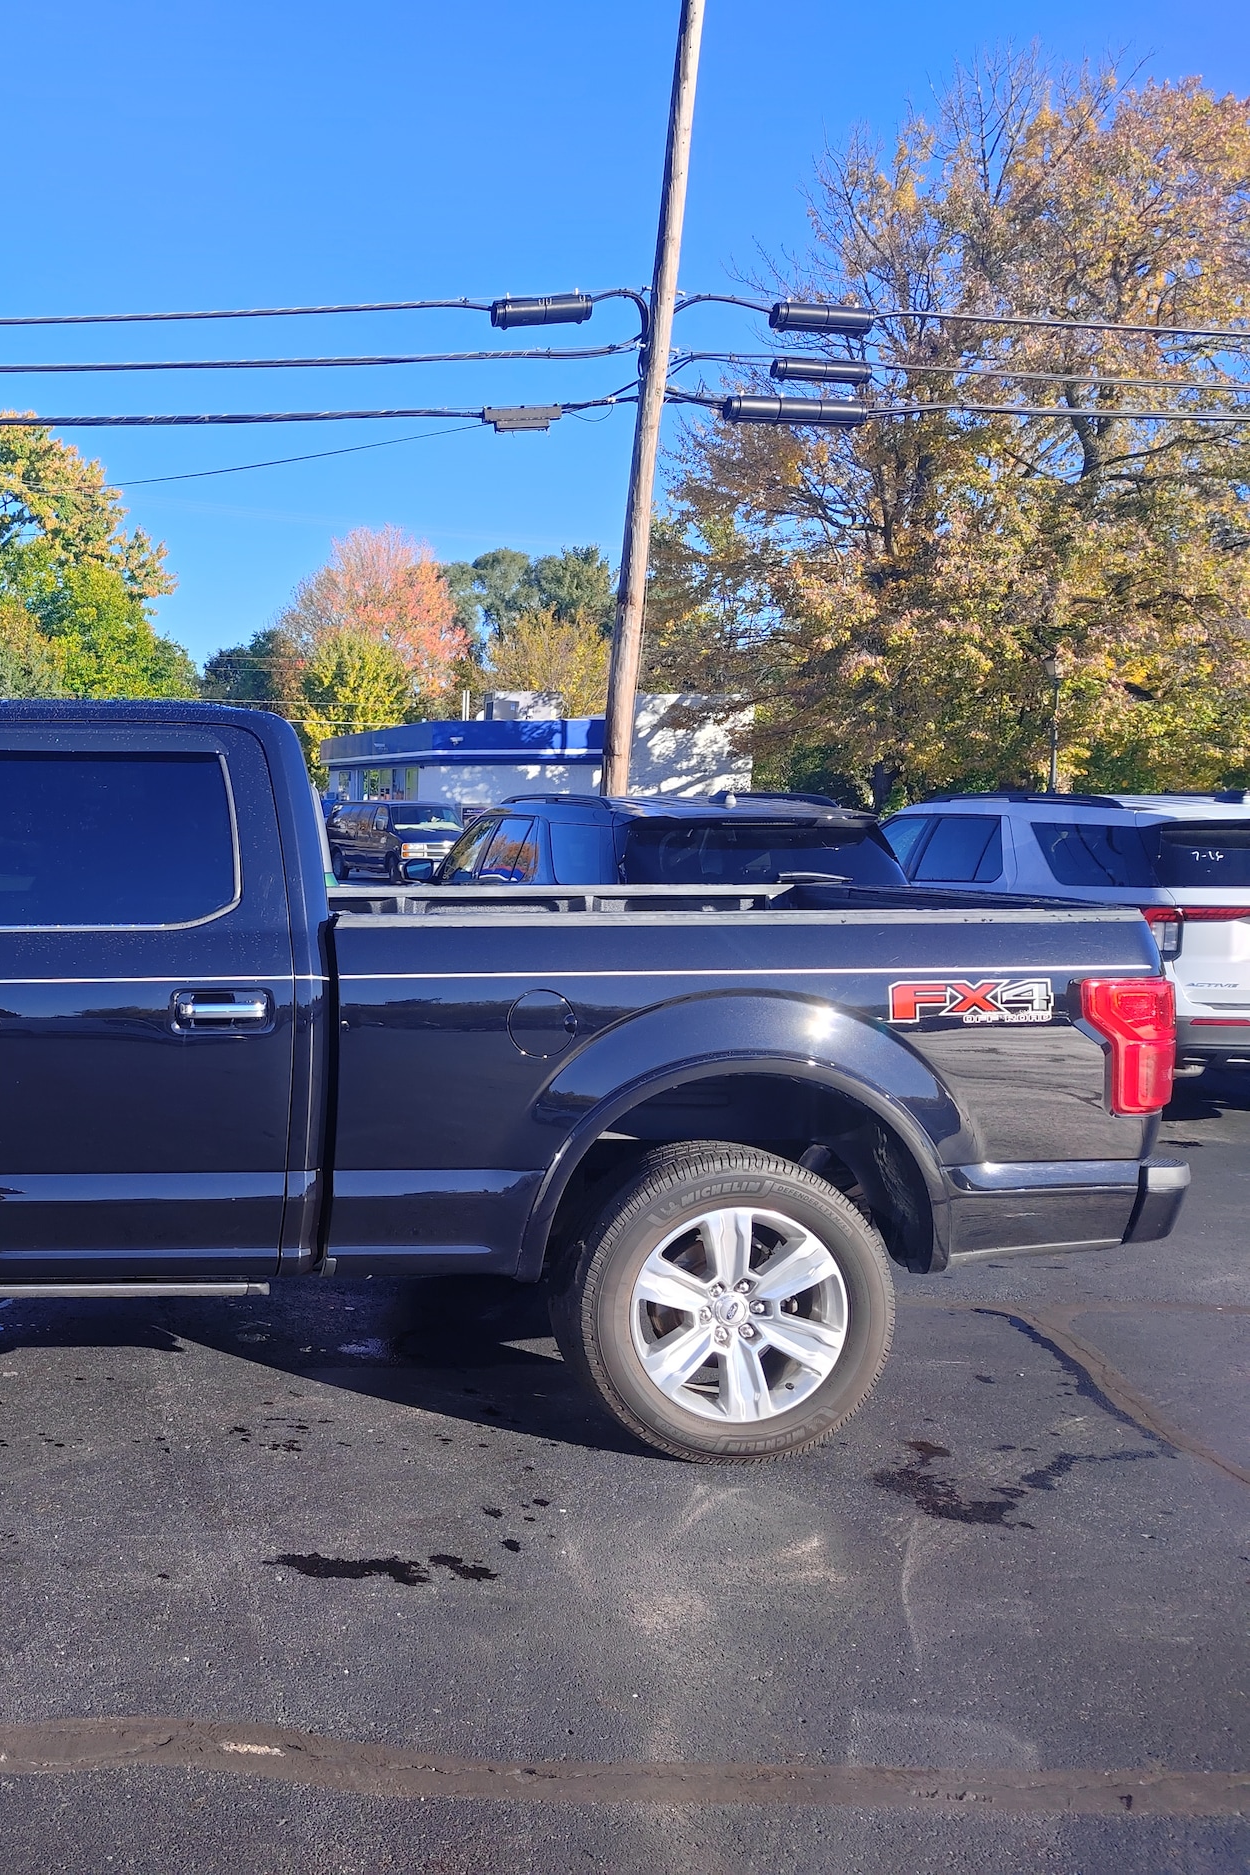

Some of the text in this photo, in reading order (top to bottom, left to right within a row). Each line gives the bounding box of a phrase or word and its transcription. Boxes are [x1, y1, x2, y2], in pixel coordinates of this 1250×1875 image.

[889, 979, 1054, 1023] FX4
[963, 1013, 1053, 1023] OFF ROAD
[680, 1181, 762, 1207] MICHELIN
[777, 1185, 819, 1207] DEFENDER
